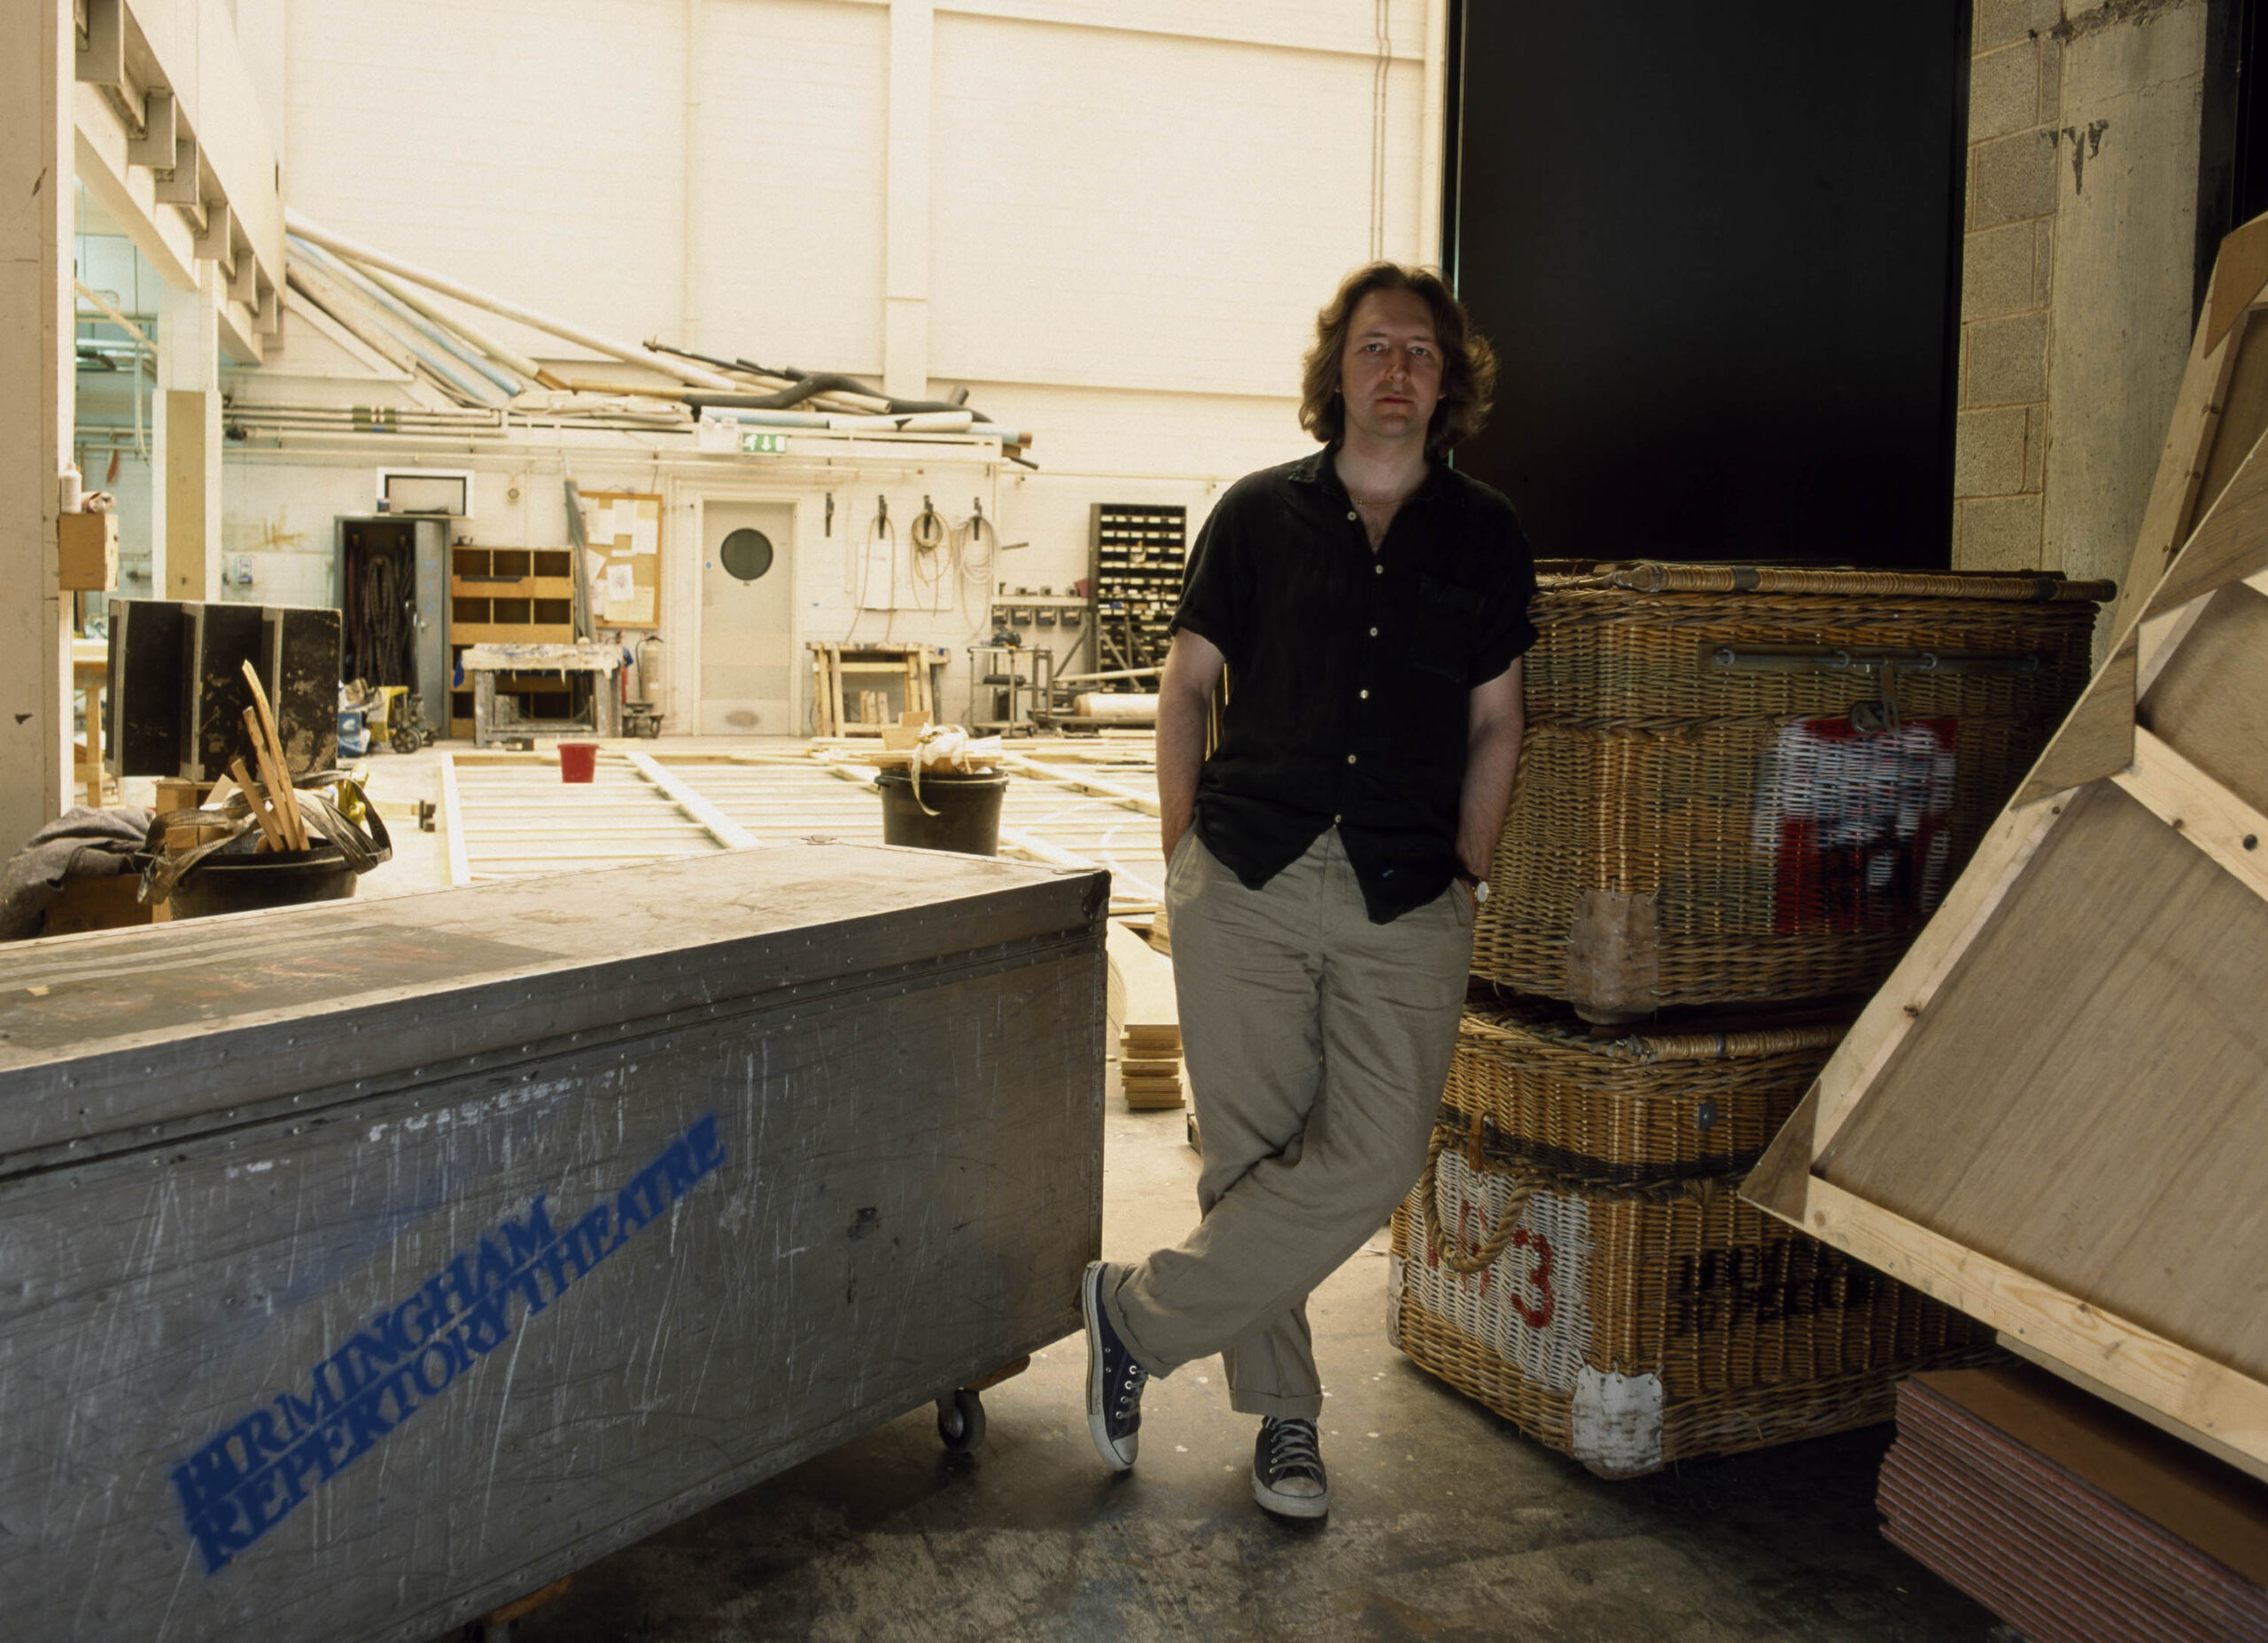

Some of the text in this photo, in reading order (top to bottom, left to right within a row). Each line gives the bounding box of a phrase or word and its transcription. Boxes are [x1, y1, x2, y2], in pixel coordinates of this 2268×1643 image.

[170, 1193, 558, 1523] BIRMINGHAM
[190, 1113, 726, 1576] REPERTORY THEATRE
